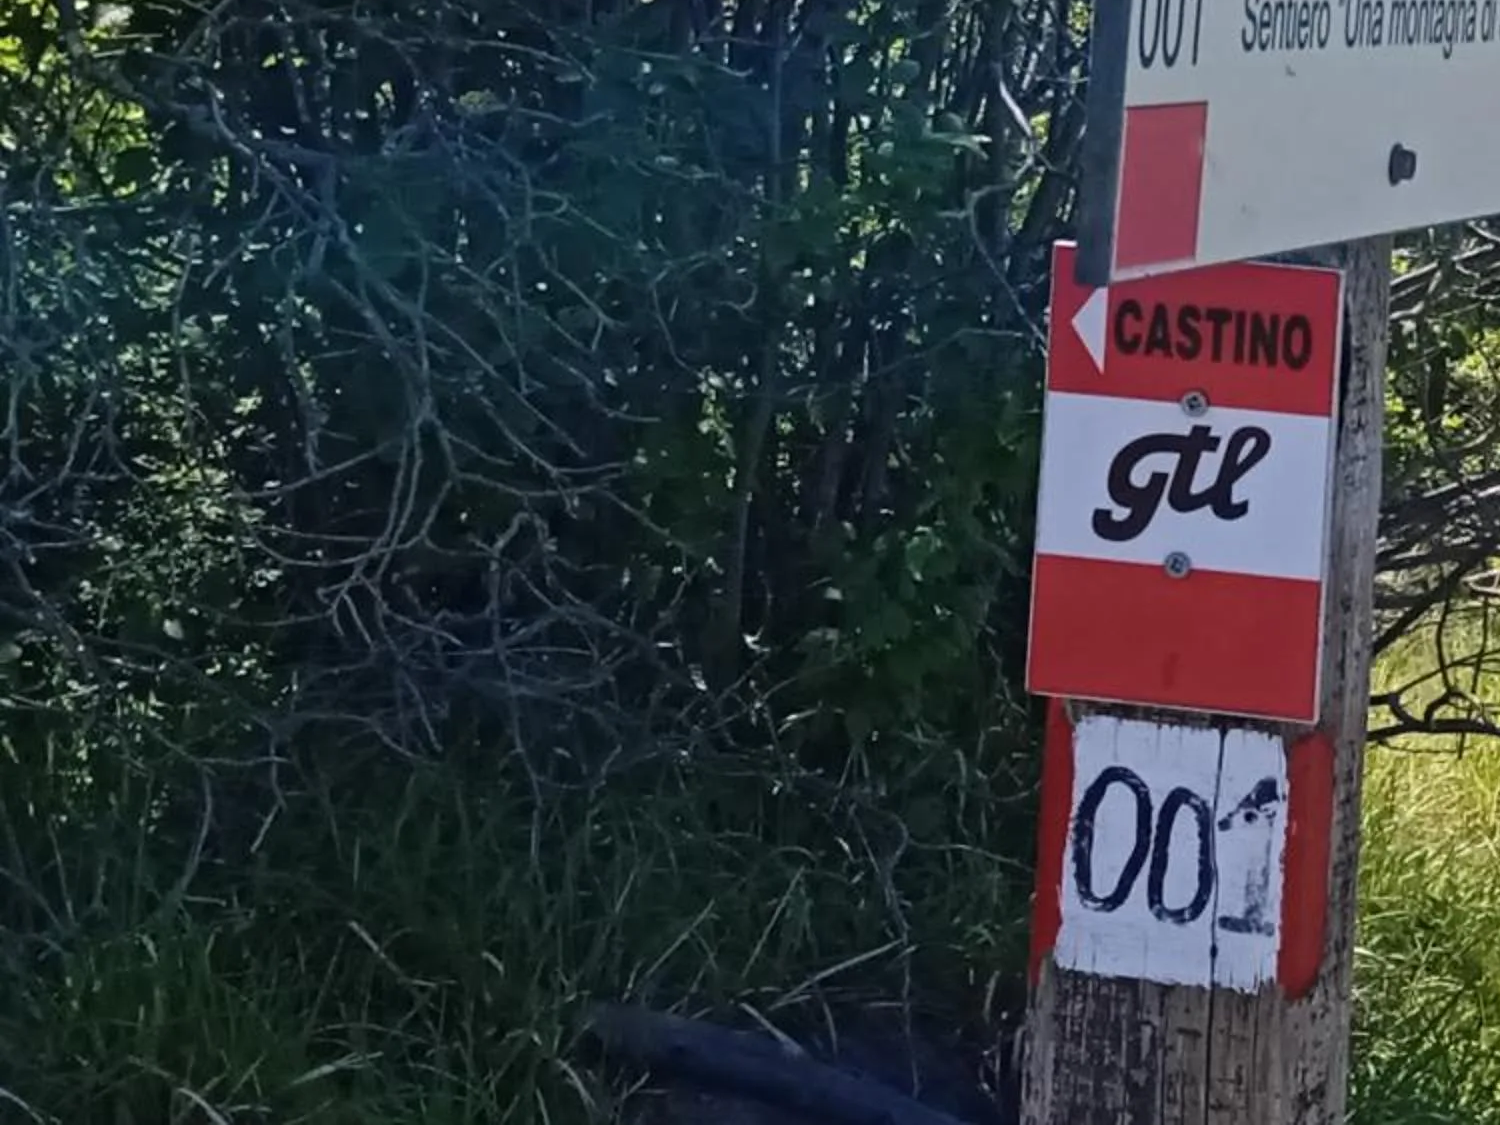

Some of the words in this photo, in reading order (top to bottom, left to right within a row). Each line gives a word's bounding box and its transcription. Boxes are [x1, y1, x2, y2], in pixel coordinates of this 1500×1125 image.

[1113, 299, 1312, 371] CASTINO
[1092, 425, 1271, 542] gtl
[1073, 766, 1286, 937] 001
